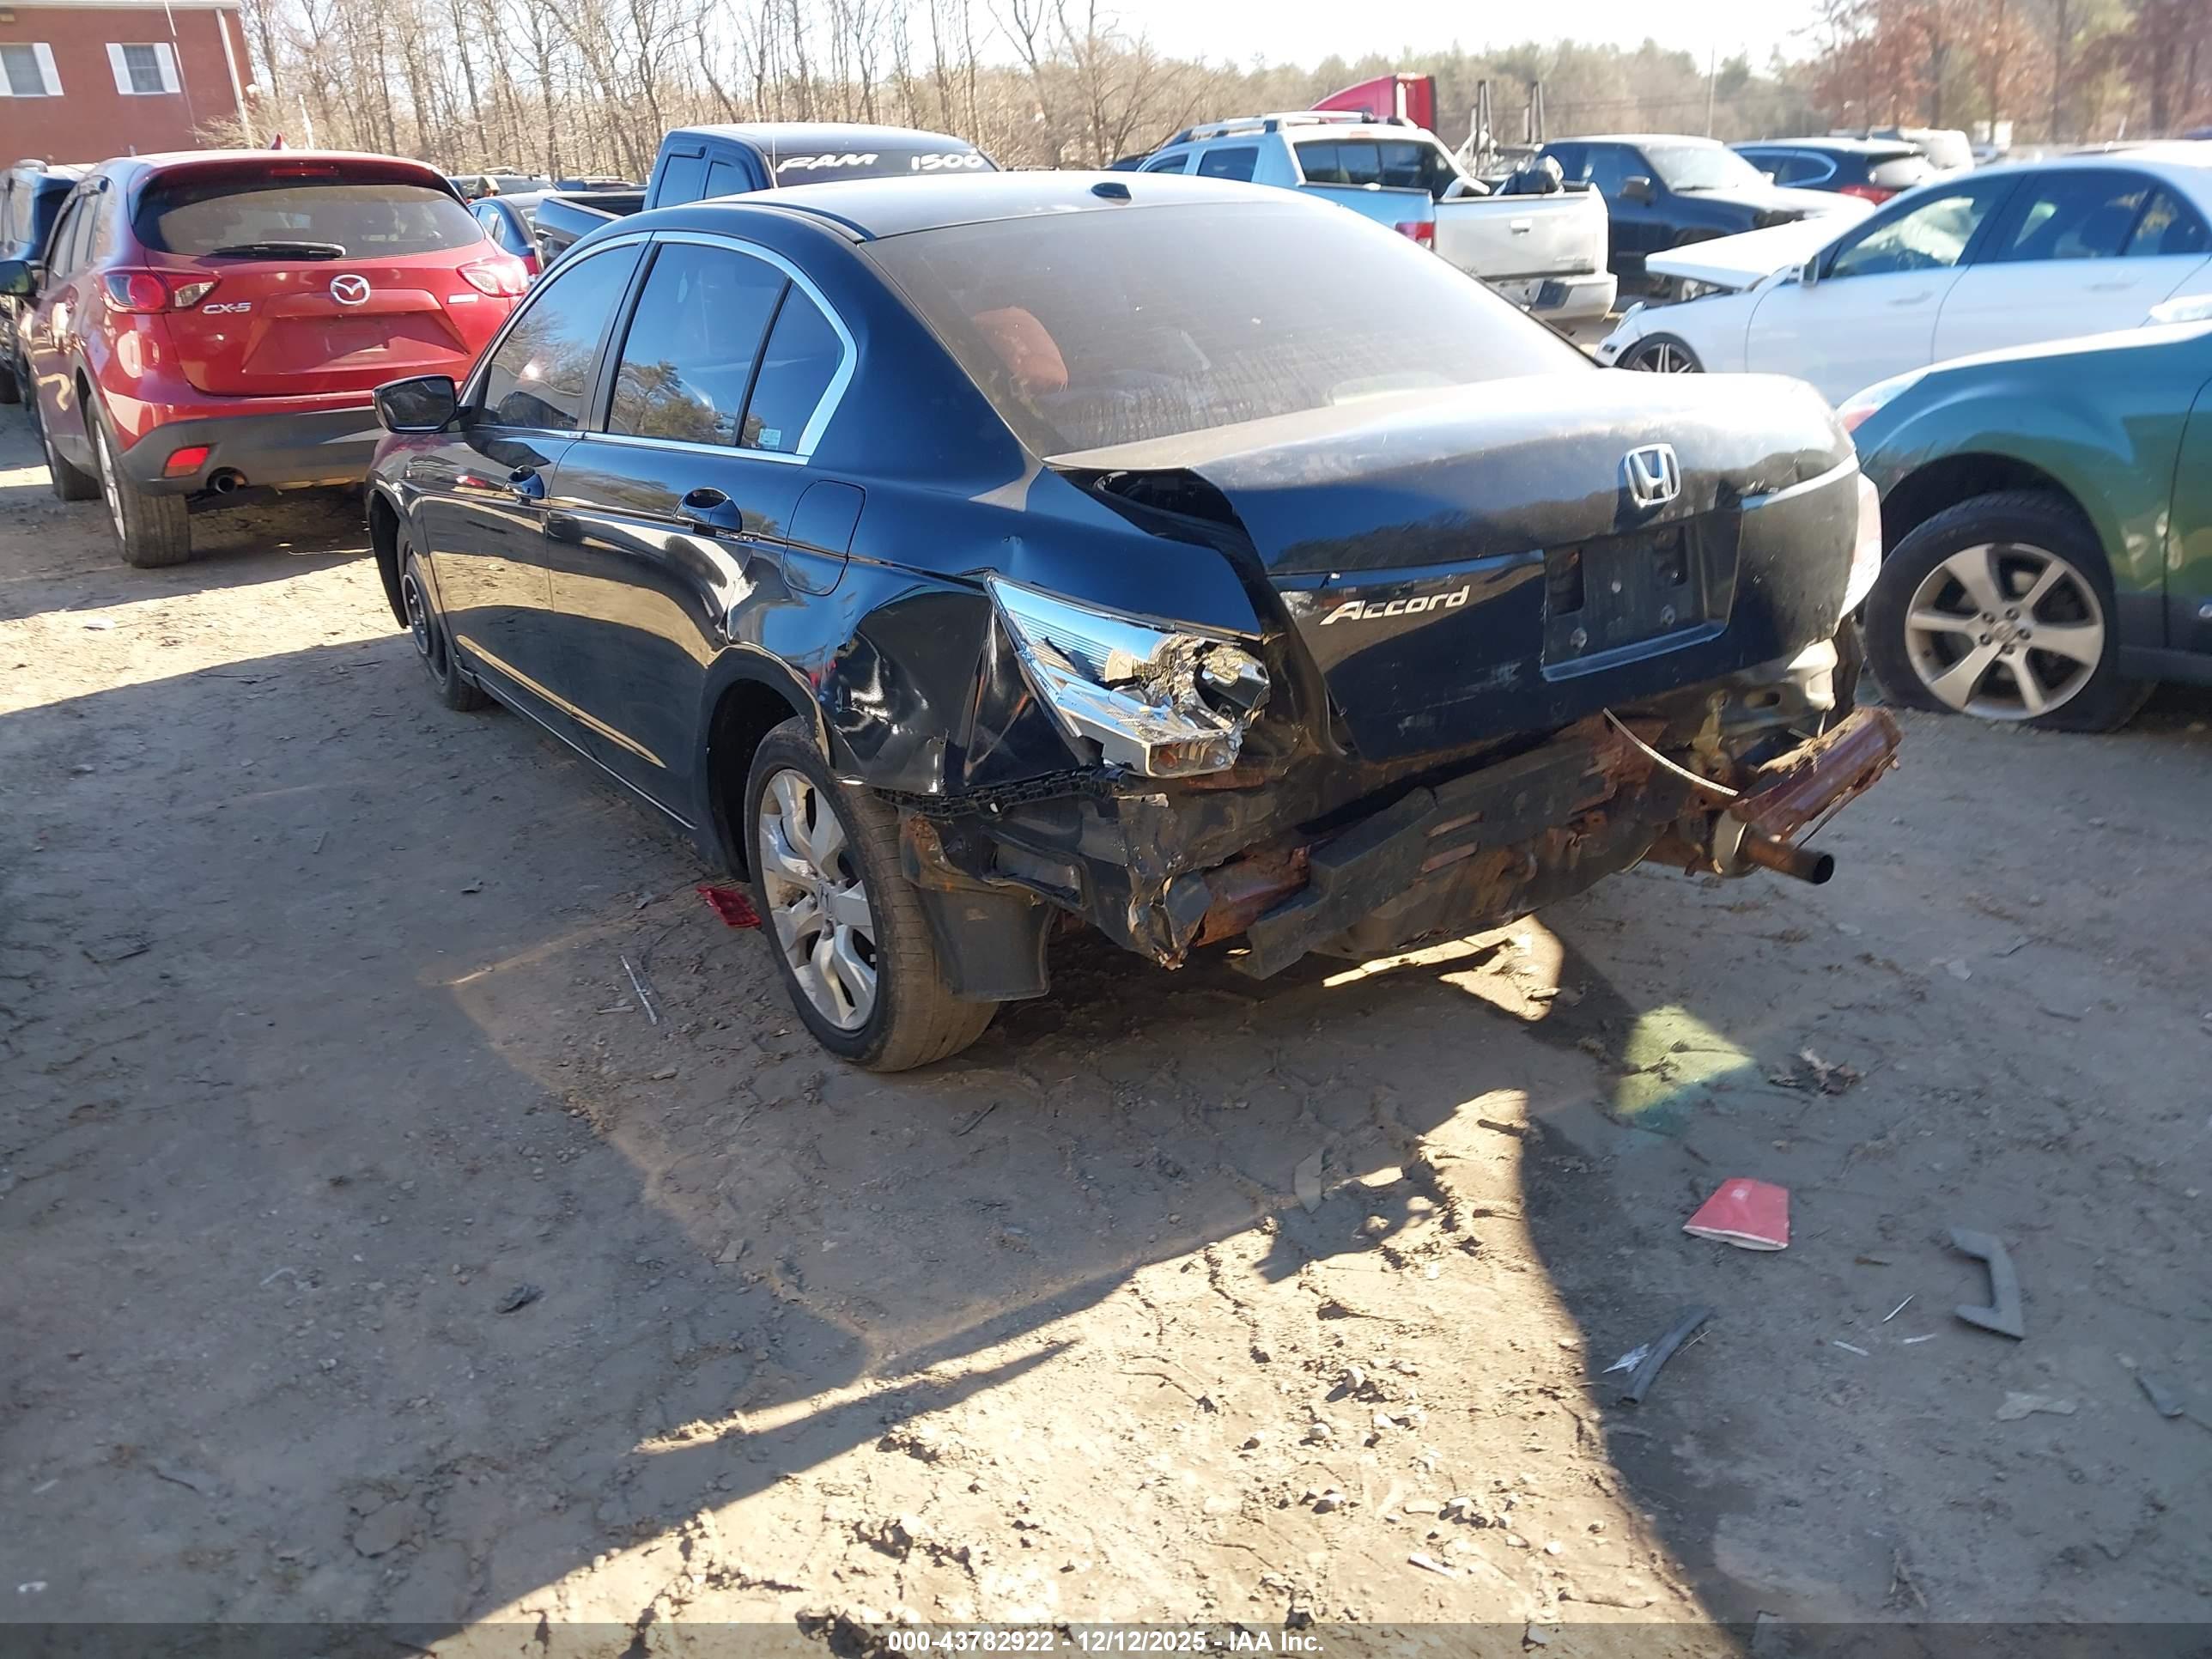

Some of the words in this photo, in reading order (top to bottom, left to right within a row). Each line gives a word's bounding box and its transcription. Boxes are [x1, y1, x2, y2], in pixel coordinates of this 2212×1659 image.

[775, 153, 878, 173] RAM
[910, 151, 984, 171] 1500
[202, 302, 252, 314] CX-5
[1319, 585, 1471, 626] Accord
